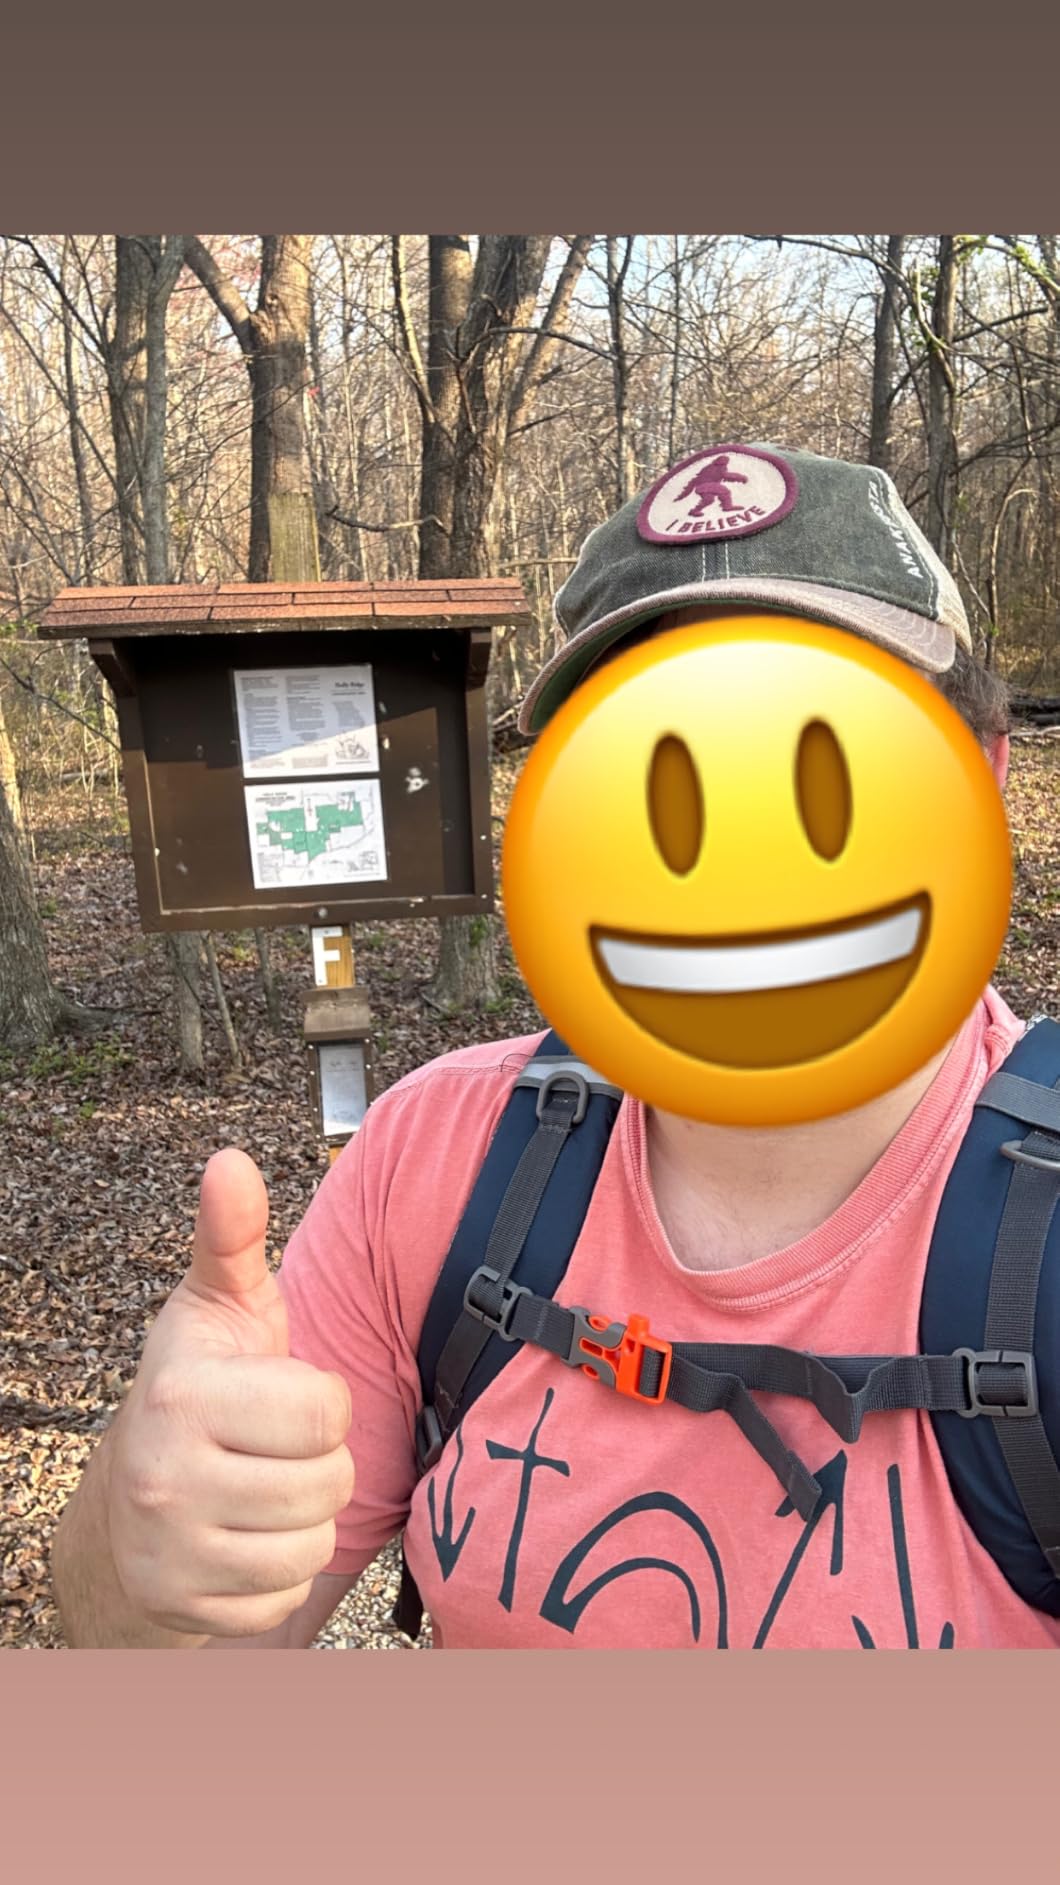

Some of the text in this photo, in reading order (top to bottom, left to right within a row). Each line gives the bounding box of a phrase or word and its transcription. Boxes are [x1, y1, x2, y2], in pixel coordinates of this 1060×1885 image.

[665, 505, 767, 533] I BELIEVE
[311, 926, 344, 987] F
